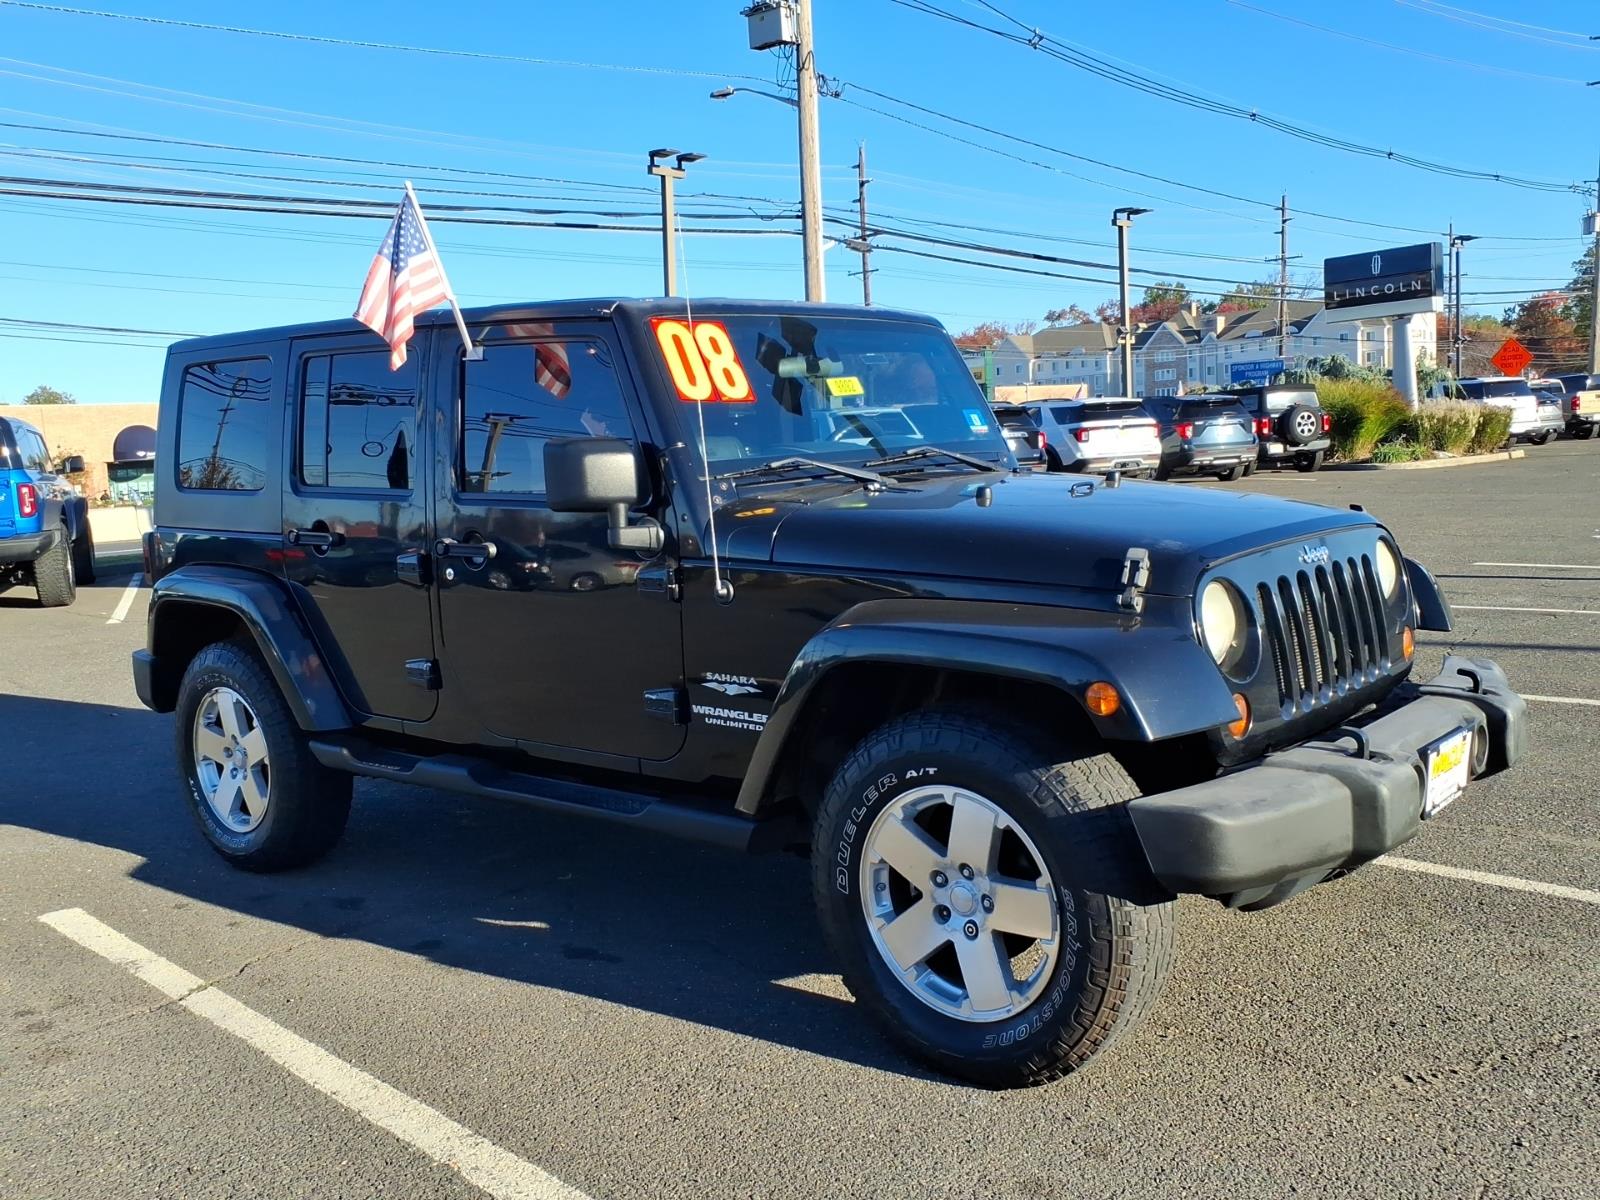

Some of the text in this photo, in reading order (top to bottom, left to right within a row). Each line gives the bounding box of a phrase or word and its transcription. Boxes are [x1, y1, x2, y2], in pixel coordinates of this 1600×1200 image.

[1333, 279, 1421, 301] LINCOLN
[657, 321, 750, 401] 08
[706, 671, 758, 686] SAHARA
[705, 717, 764, 731] UNLIMITED
[836, 767, 938, 895] DUELER A/T
[982, 885, 1083, 1049] BRIDGESTONE
